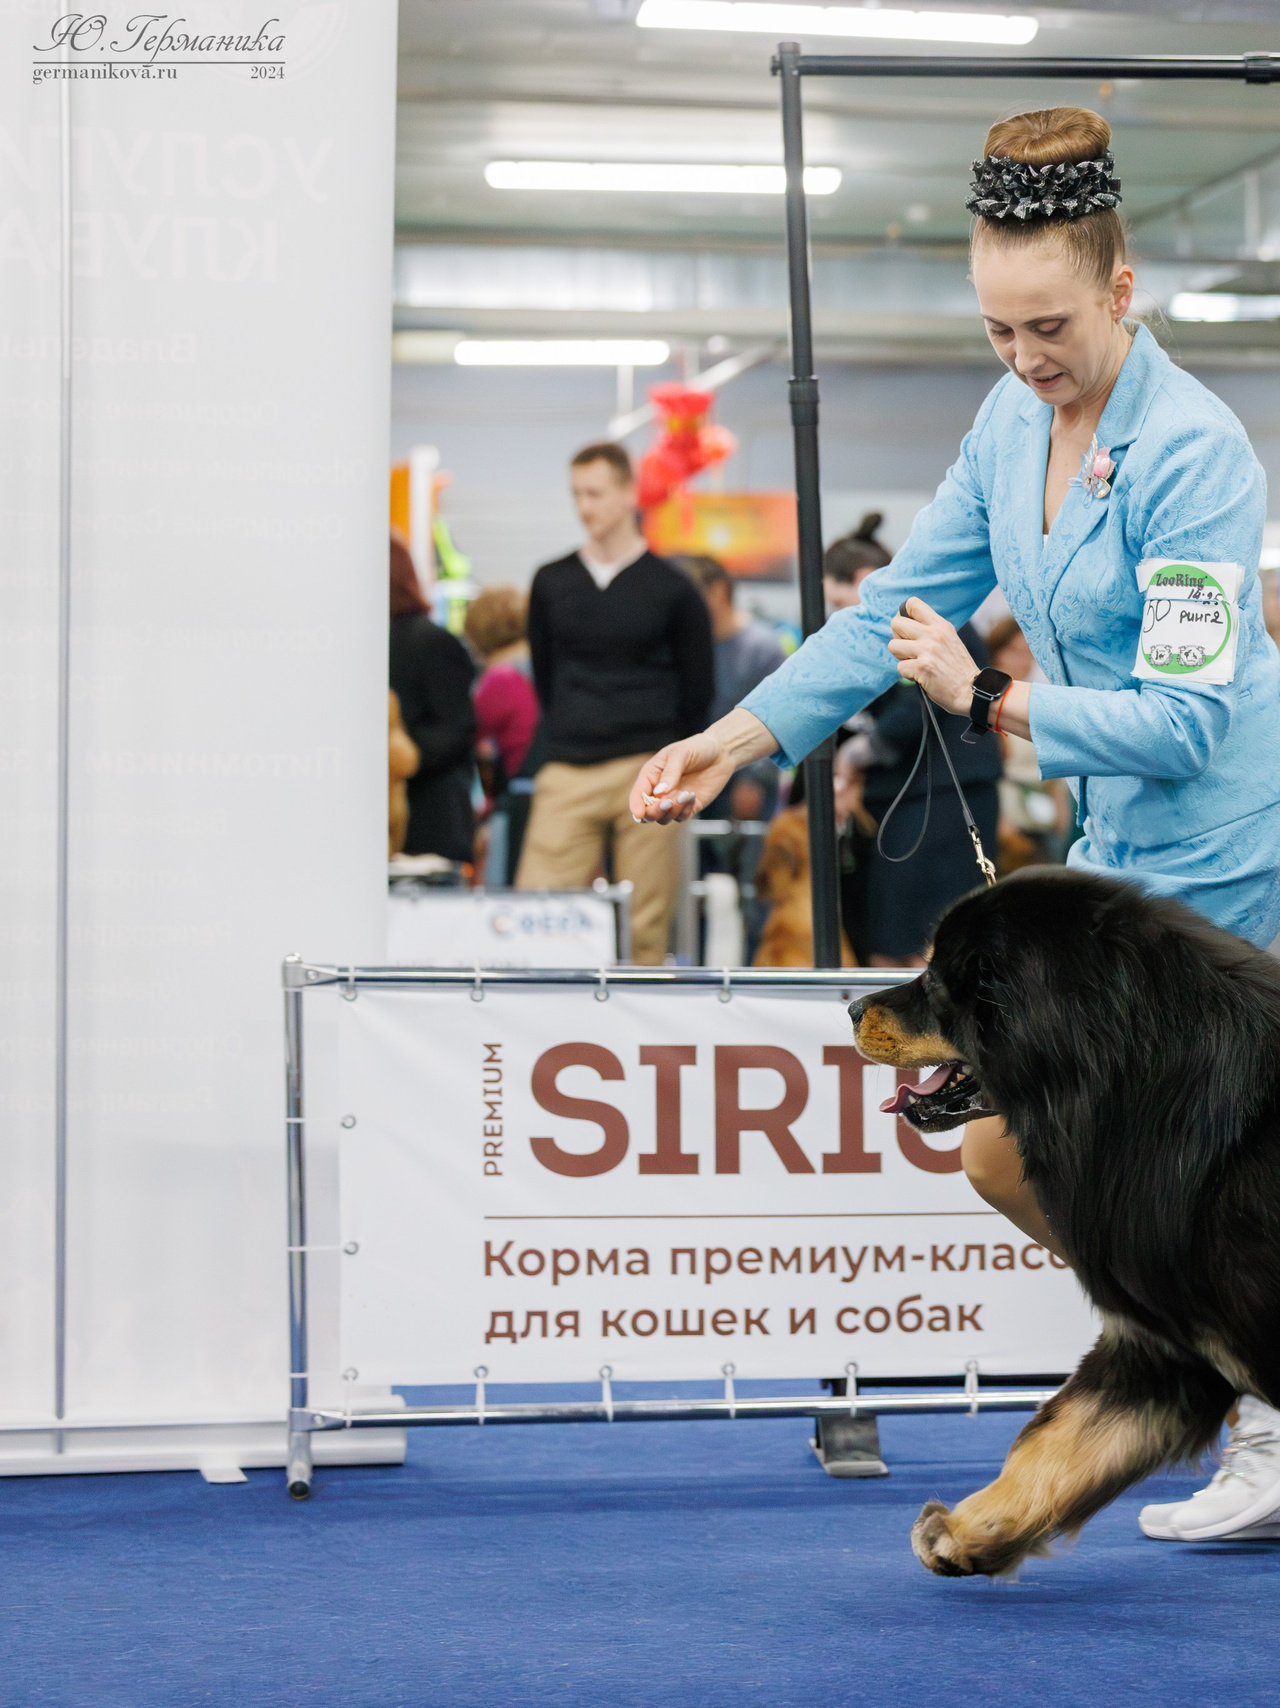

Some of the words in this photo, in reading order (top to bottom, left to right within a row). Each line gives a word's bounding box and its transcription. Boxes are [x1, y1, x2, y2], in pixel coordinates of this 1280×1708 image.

[1155, 573, 1205, 592] ZooRing
[483, 1042, 504, 1178] PREMIUM
[484, 1239, 650, 1287] Корма
[484, 1308, 580, 1345] для
[601, 1302, 770, 1340] кошек
[789, 1306, 817, 1335] и
[835, 1293, 984, 1335] собак
